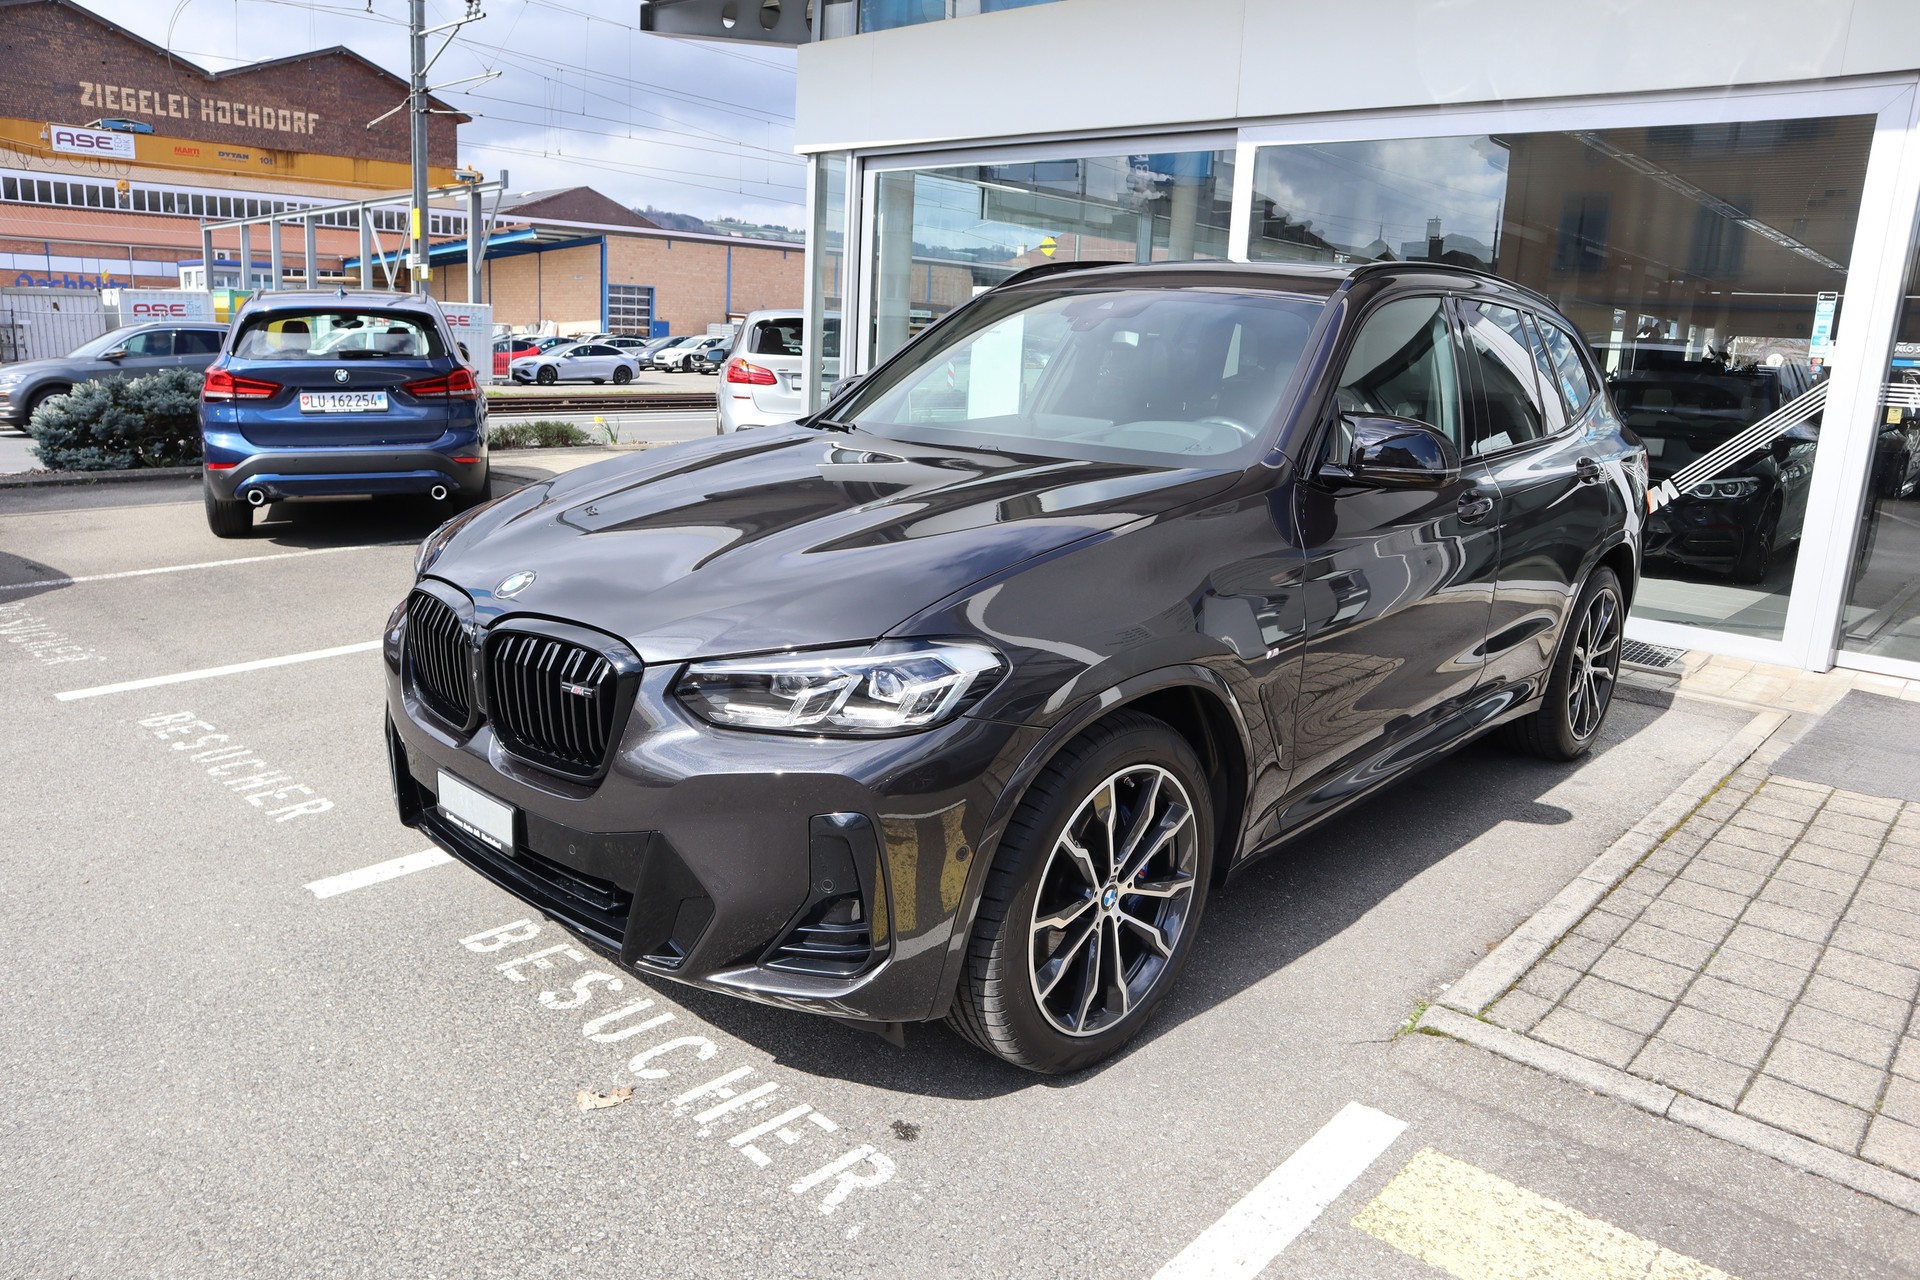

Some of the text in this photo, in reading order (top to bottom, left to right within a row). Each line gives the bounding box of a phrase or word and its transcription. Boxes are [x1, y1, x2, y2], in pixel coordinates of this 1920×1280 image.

[79, 81, 319, 134] ZIEGELEI HOCHDORF
[56, 131, 113, 150] ASE
[174, 146, 200, 155] MARTI
[218, 151, 249, 160] DYTAN
[260, 157, 273, 165] 101
[133, 303, 187, 317] ASE
[444, 314, 471, 326] SE
[138, 711, 335, 823] BESUCHER
[458, 918, 897, 1217] BESUCHER
